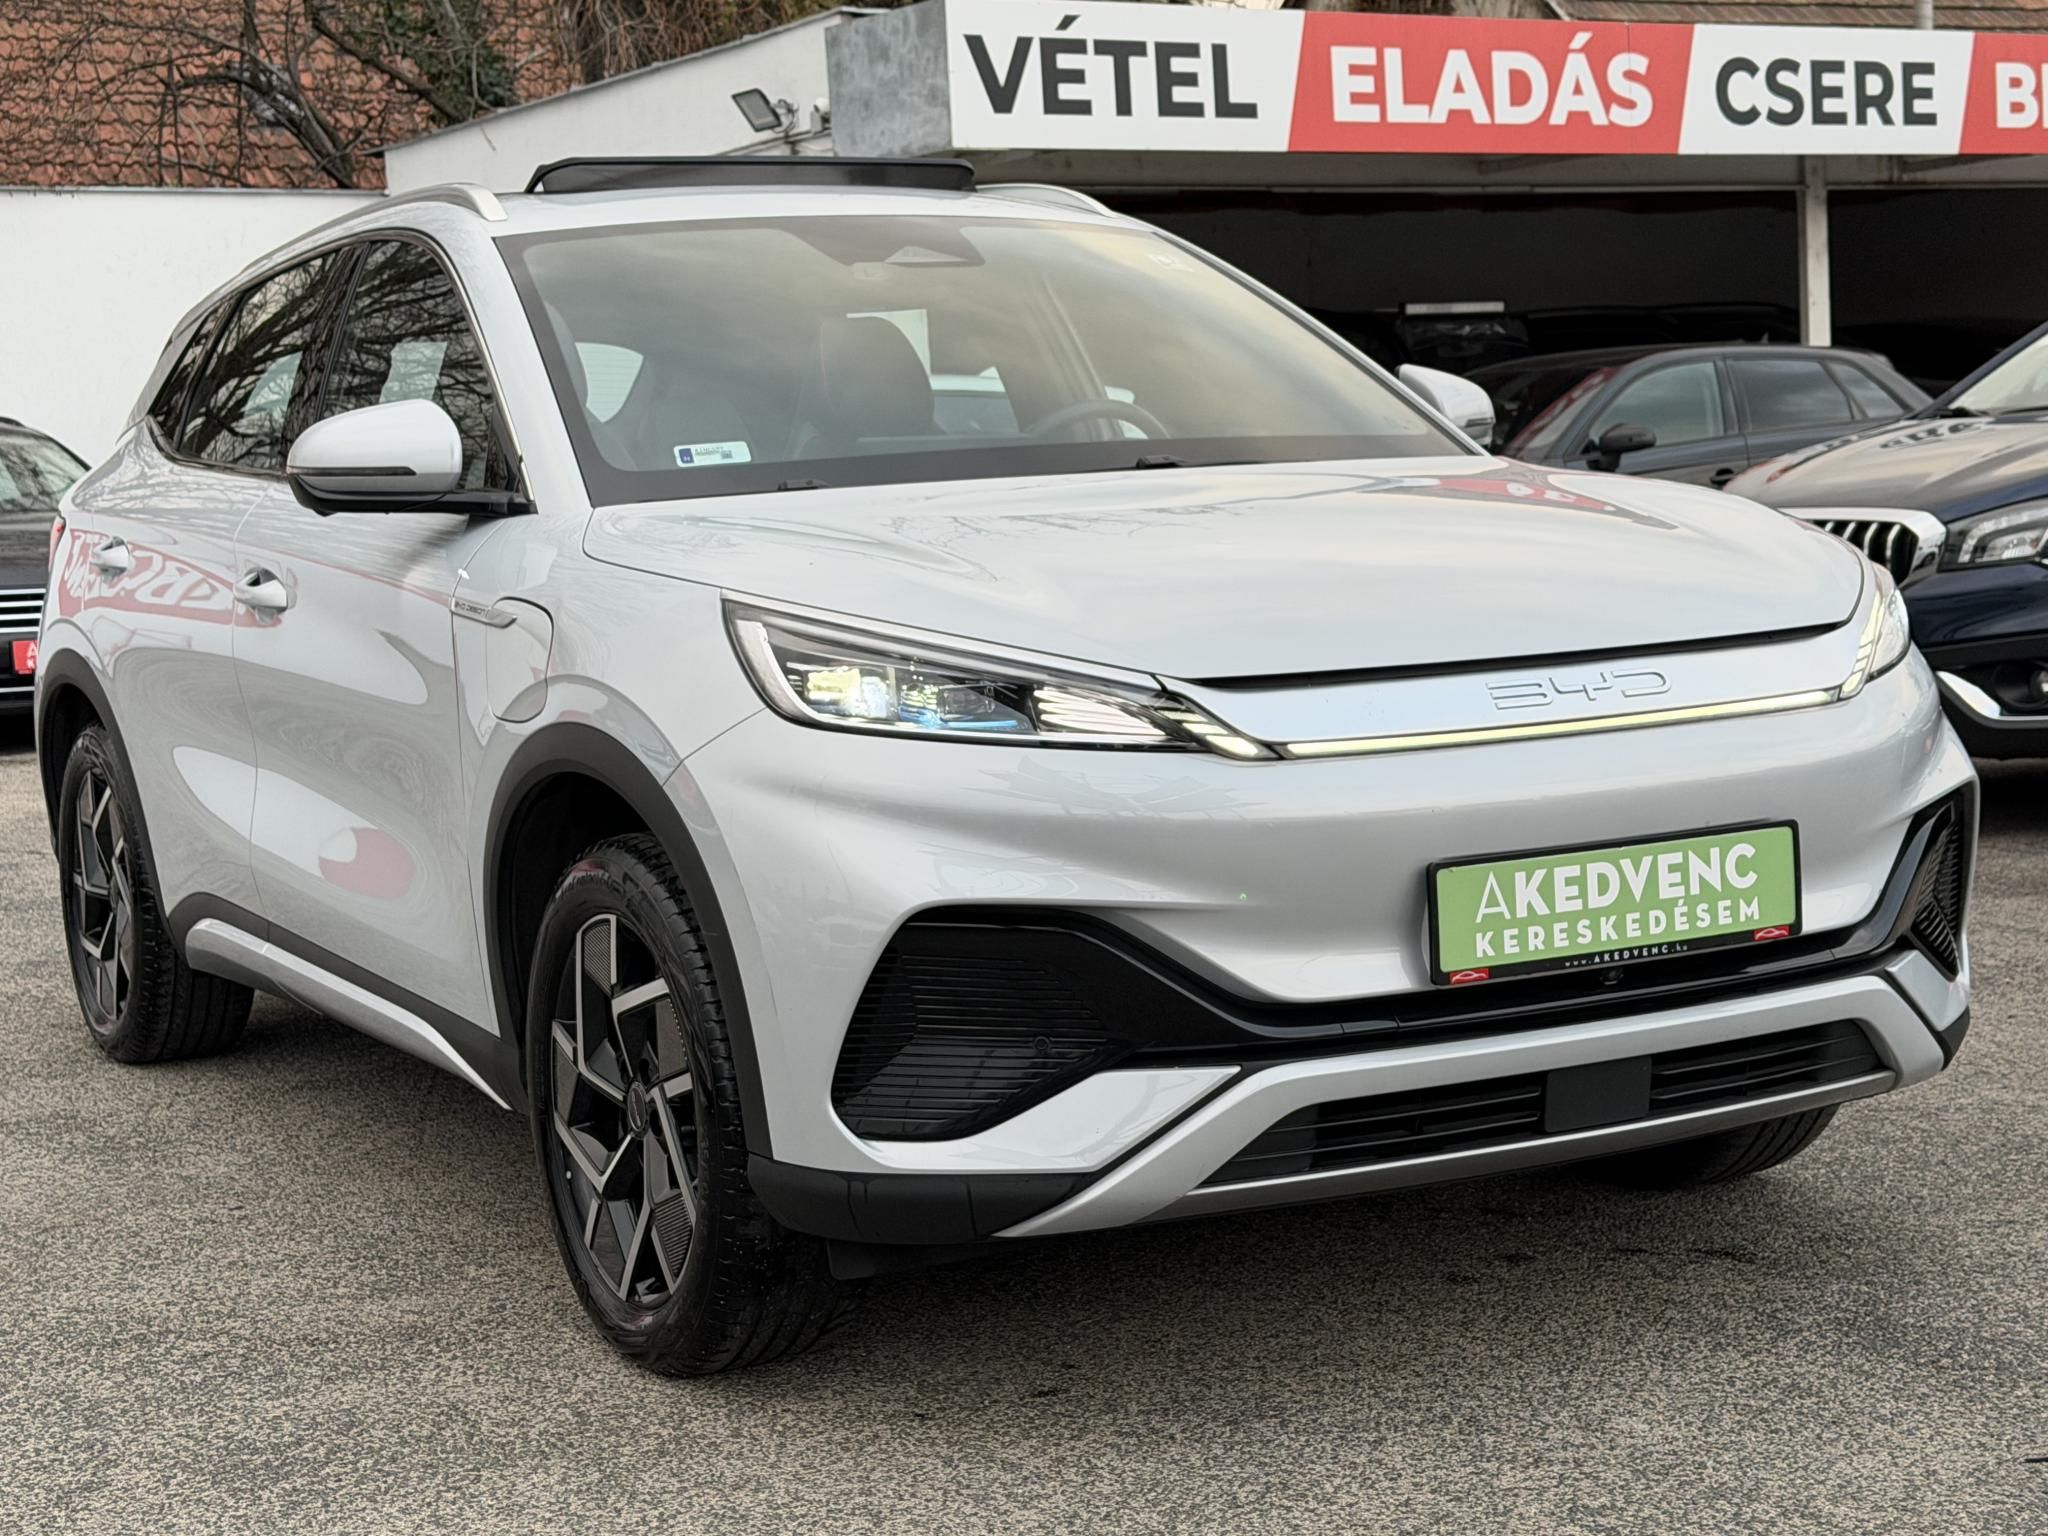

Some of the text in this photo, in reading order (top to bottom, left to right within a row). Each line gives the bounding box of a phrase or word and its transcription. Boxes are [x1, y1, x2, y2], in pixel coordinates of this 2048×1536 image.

[963, 14, 2048, 129] VÉTEL ELADÁS CSERE B
[1486, 669, 1671, 710] BYD
[1475, 897, 1760, 958] KERESKEDÉSEM
